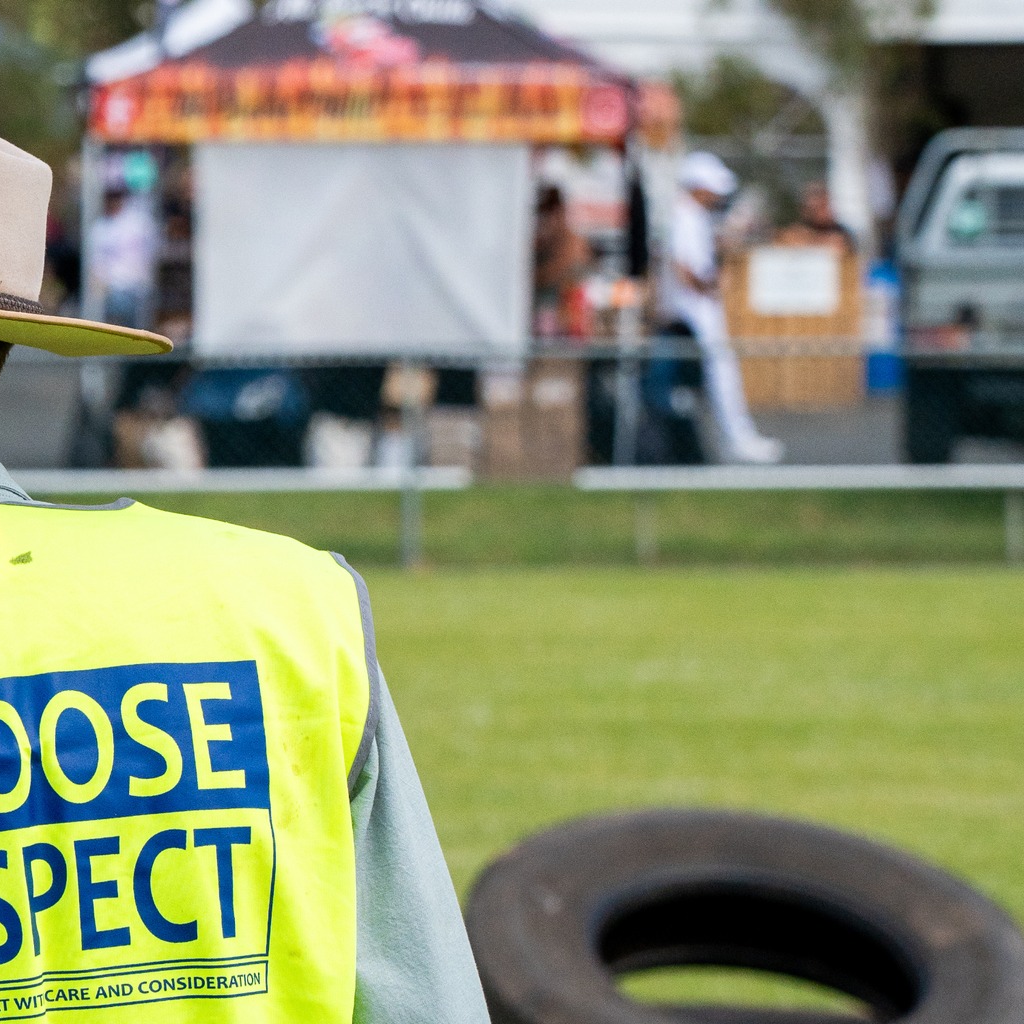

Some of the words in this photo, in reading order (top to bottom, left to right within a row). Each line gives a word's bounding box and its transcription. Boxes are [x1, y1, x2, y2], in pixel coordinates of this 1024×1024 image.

[14, 993, 44, 1011] WIT
[45, 988, 91, 1002] CARE
[95, 983, 134, 999] AND
[138, 972, 261, 994] CONSIDERATION
